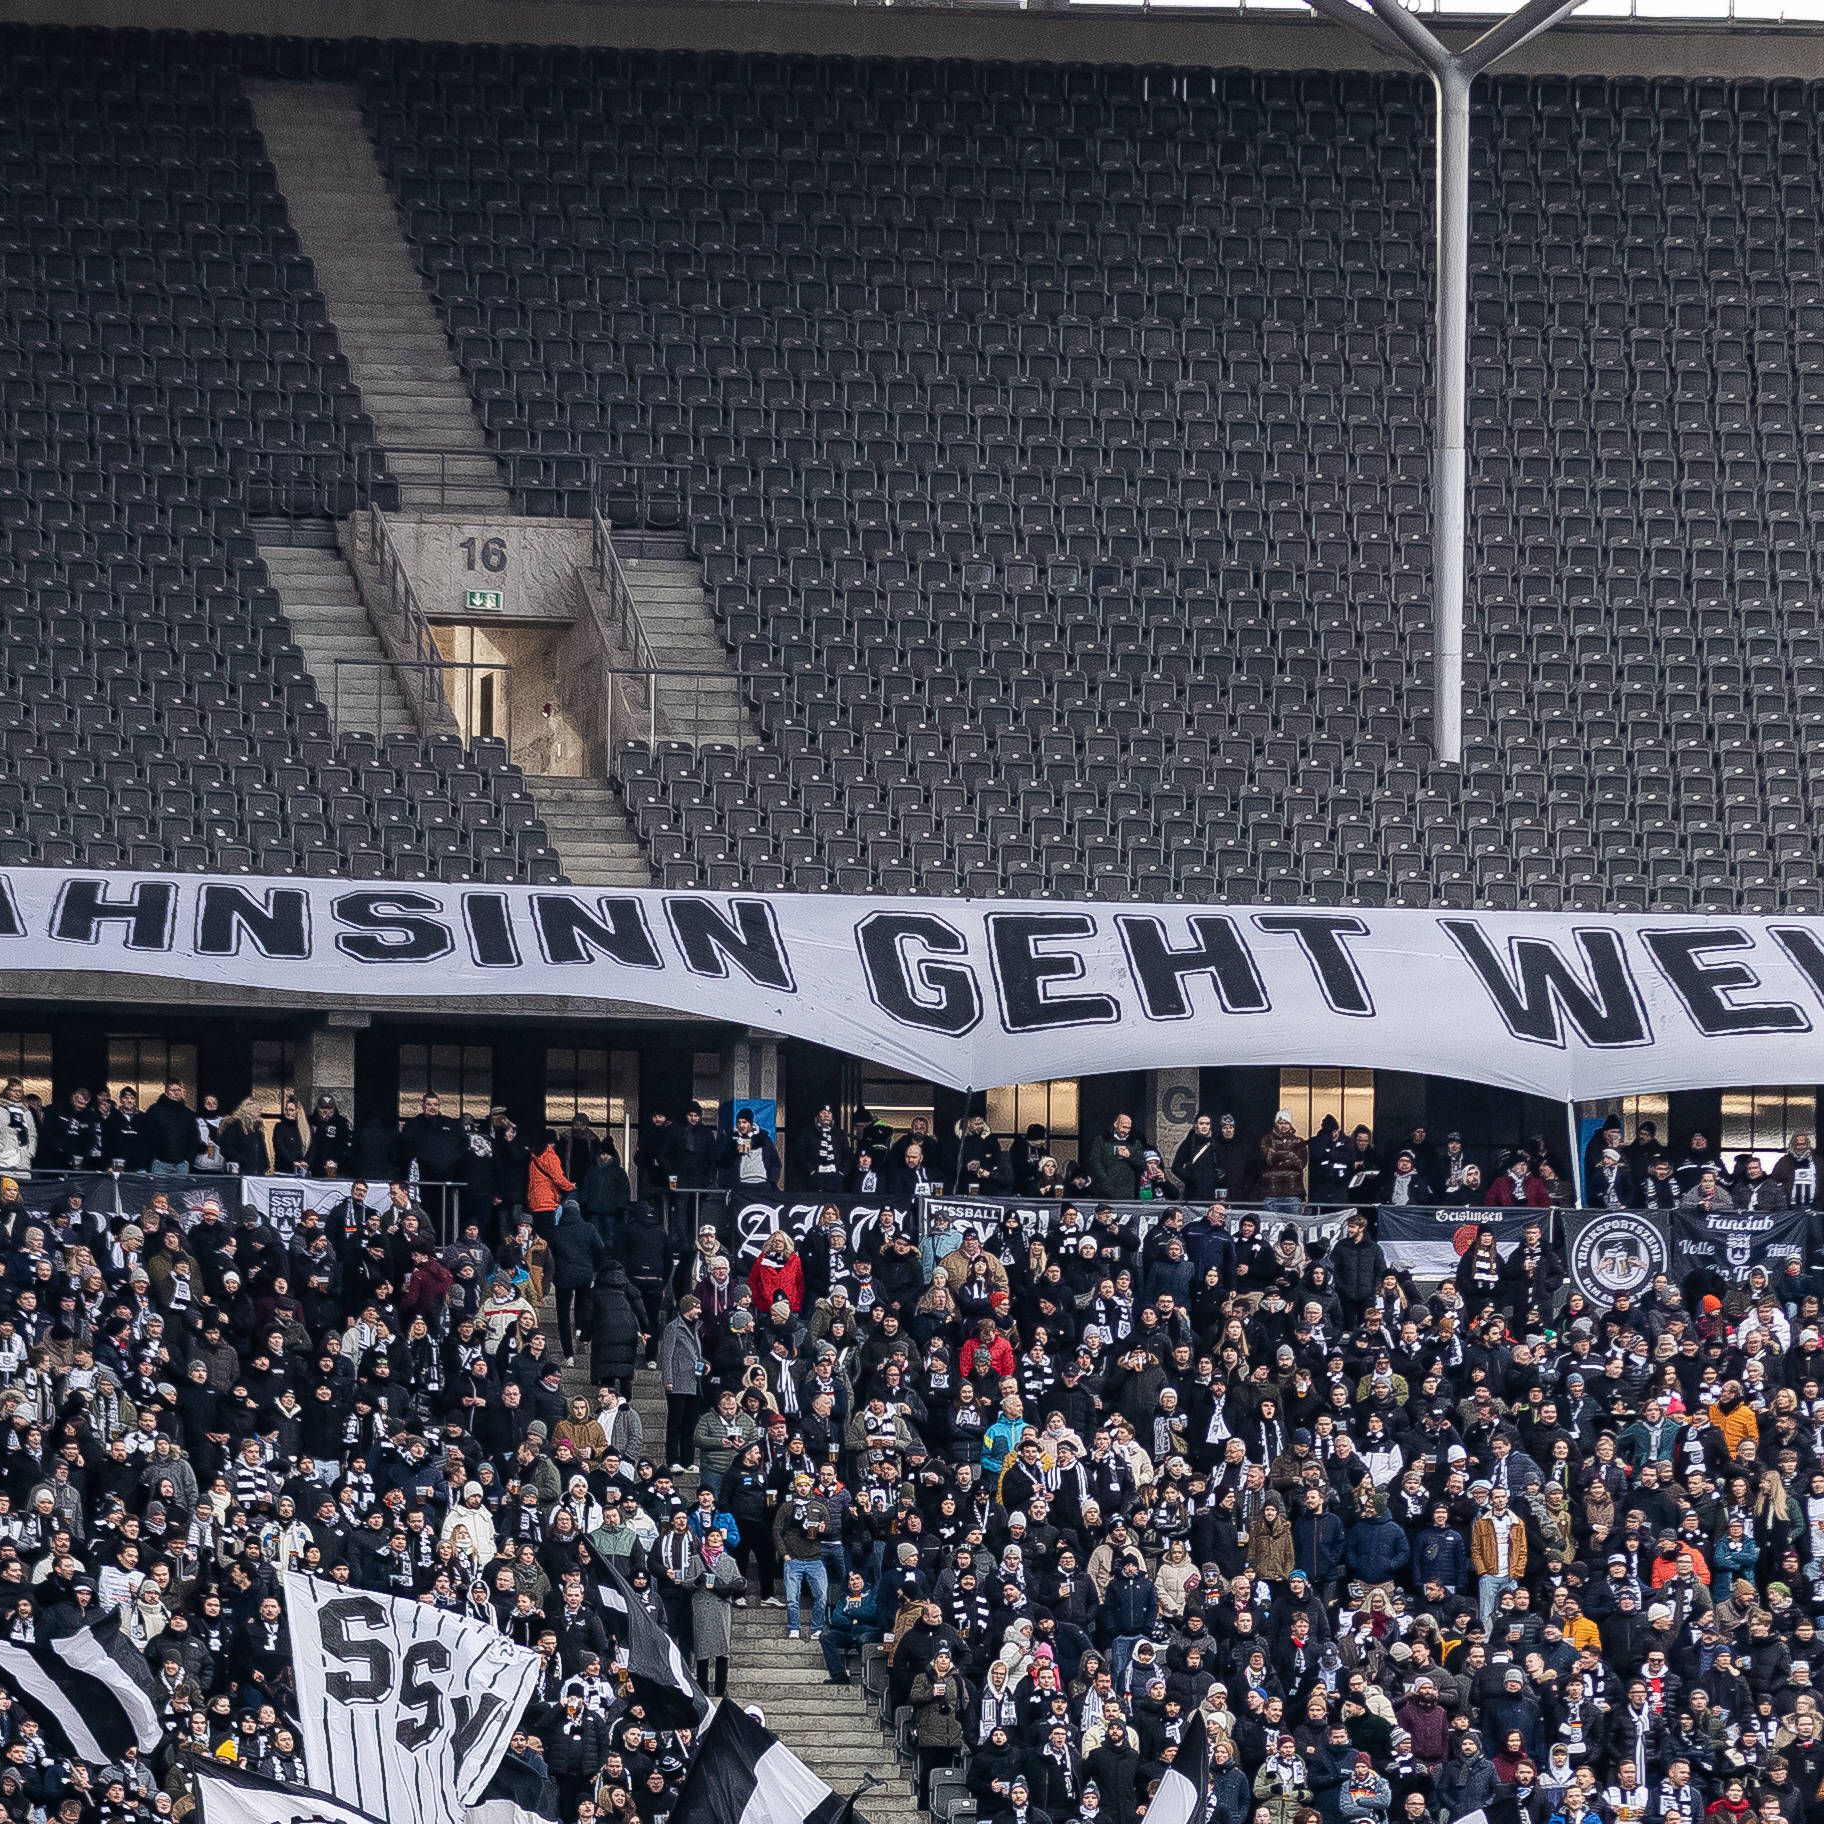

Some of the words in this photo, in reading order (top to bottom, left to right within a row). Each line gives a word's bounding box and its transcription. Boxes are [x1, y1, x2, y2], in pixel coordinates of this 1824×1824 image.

[460, 537, 507, 573] 16
[856, 909, 1378, 1039] GEHT
[1161, 1085, 1198, 1124] G
[272, 1196, 307, 1210] SSV
[931, 1204, 997, 1220] FUSSBALL
[1705, 1213, 1776, 1231] Fanclub
[1678, 1240, 1716, 1256] Volle
